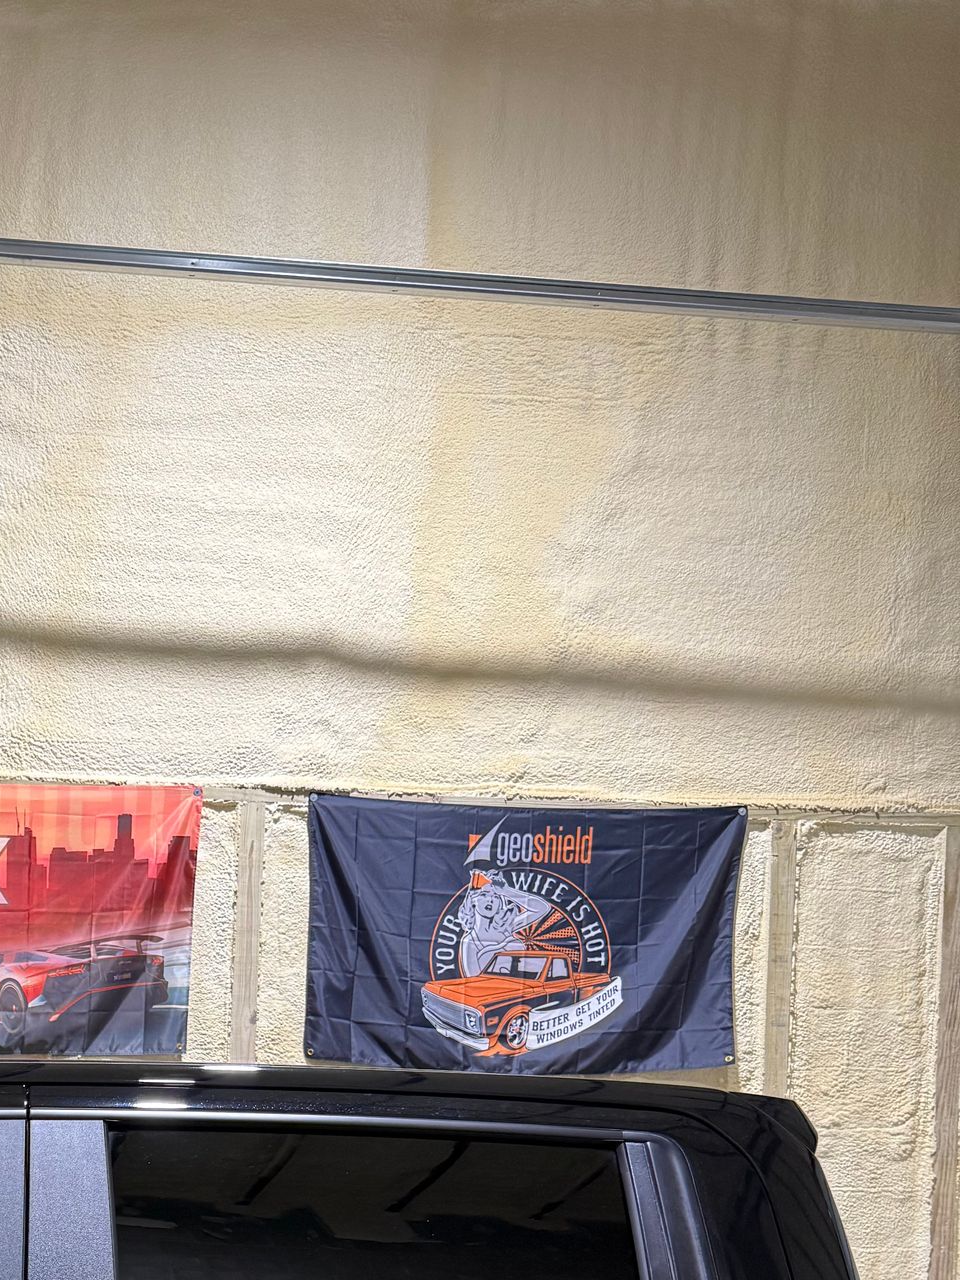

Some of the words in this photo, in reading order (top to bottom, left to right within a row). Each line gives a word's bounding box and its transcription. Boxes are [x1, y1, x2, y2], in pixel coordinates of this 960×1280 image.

[496, 825, 593, 866] geoshield
[435, 914, 464, 974] YOUR
[511, 871, 569, 903] WIFE
[565, 896, 590, 921] IS
[581, 921, 606, 966] HOT
[532, 1012, 569, 1032] BETTER
[575, 1002, 592, 1017] GET
[596, 985, 619, 1004] YOUR
[536, 1019, 584, 1044] WINDOWS
[588, 998, 616, 1022] TINTED
